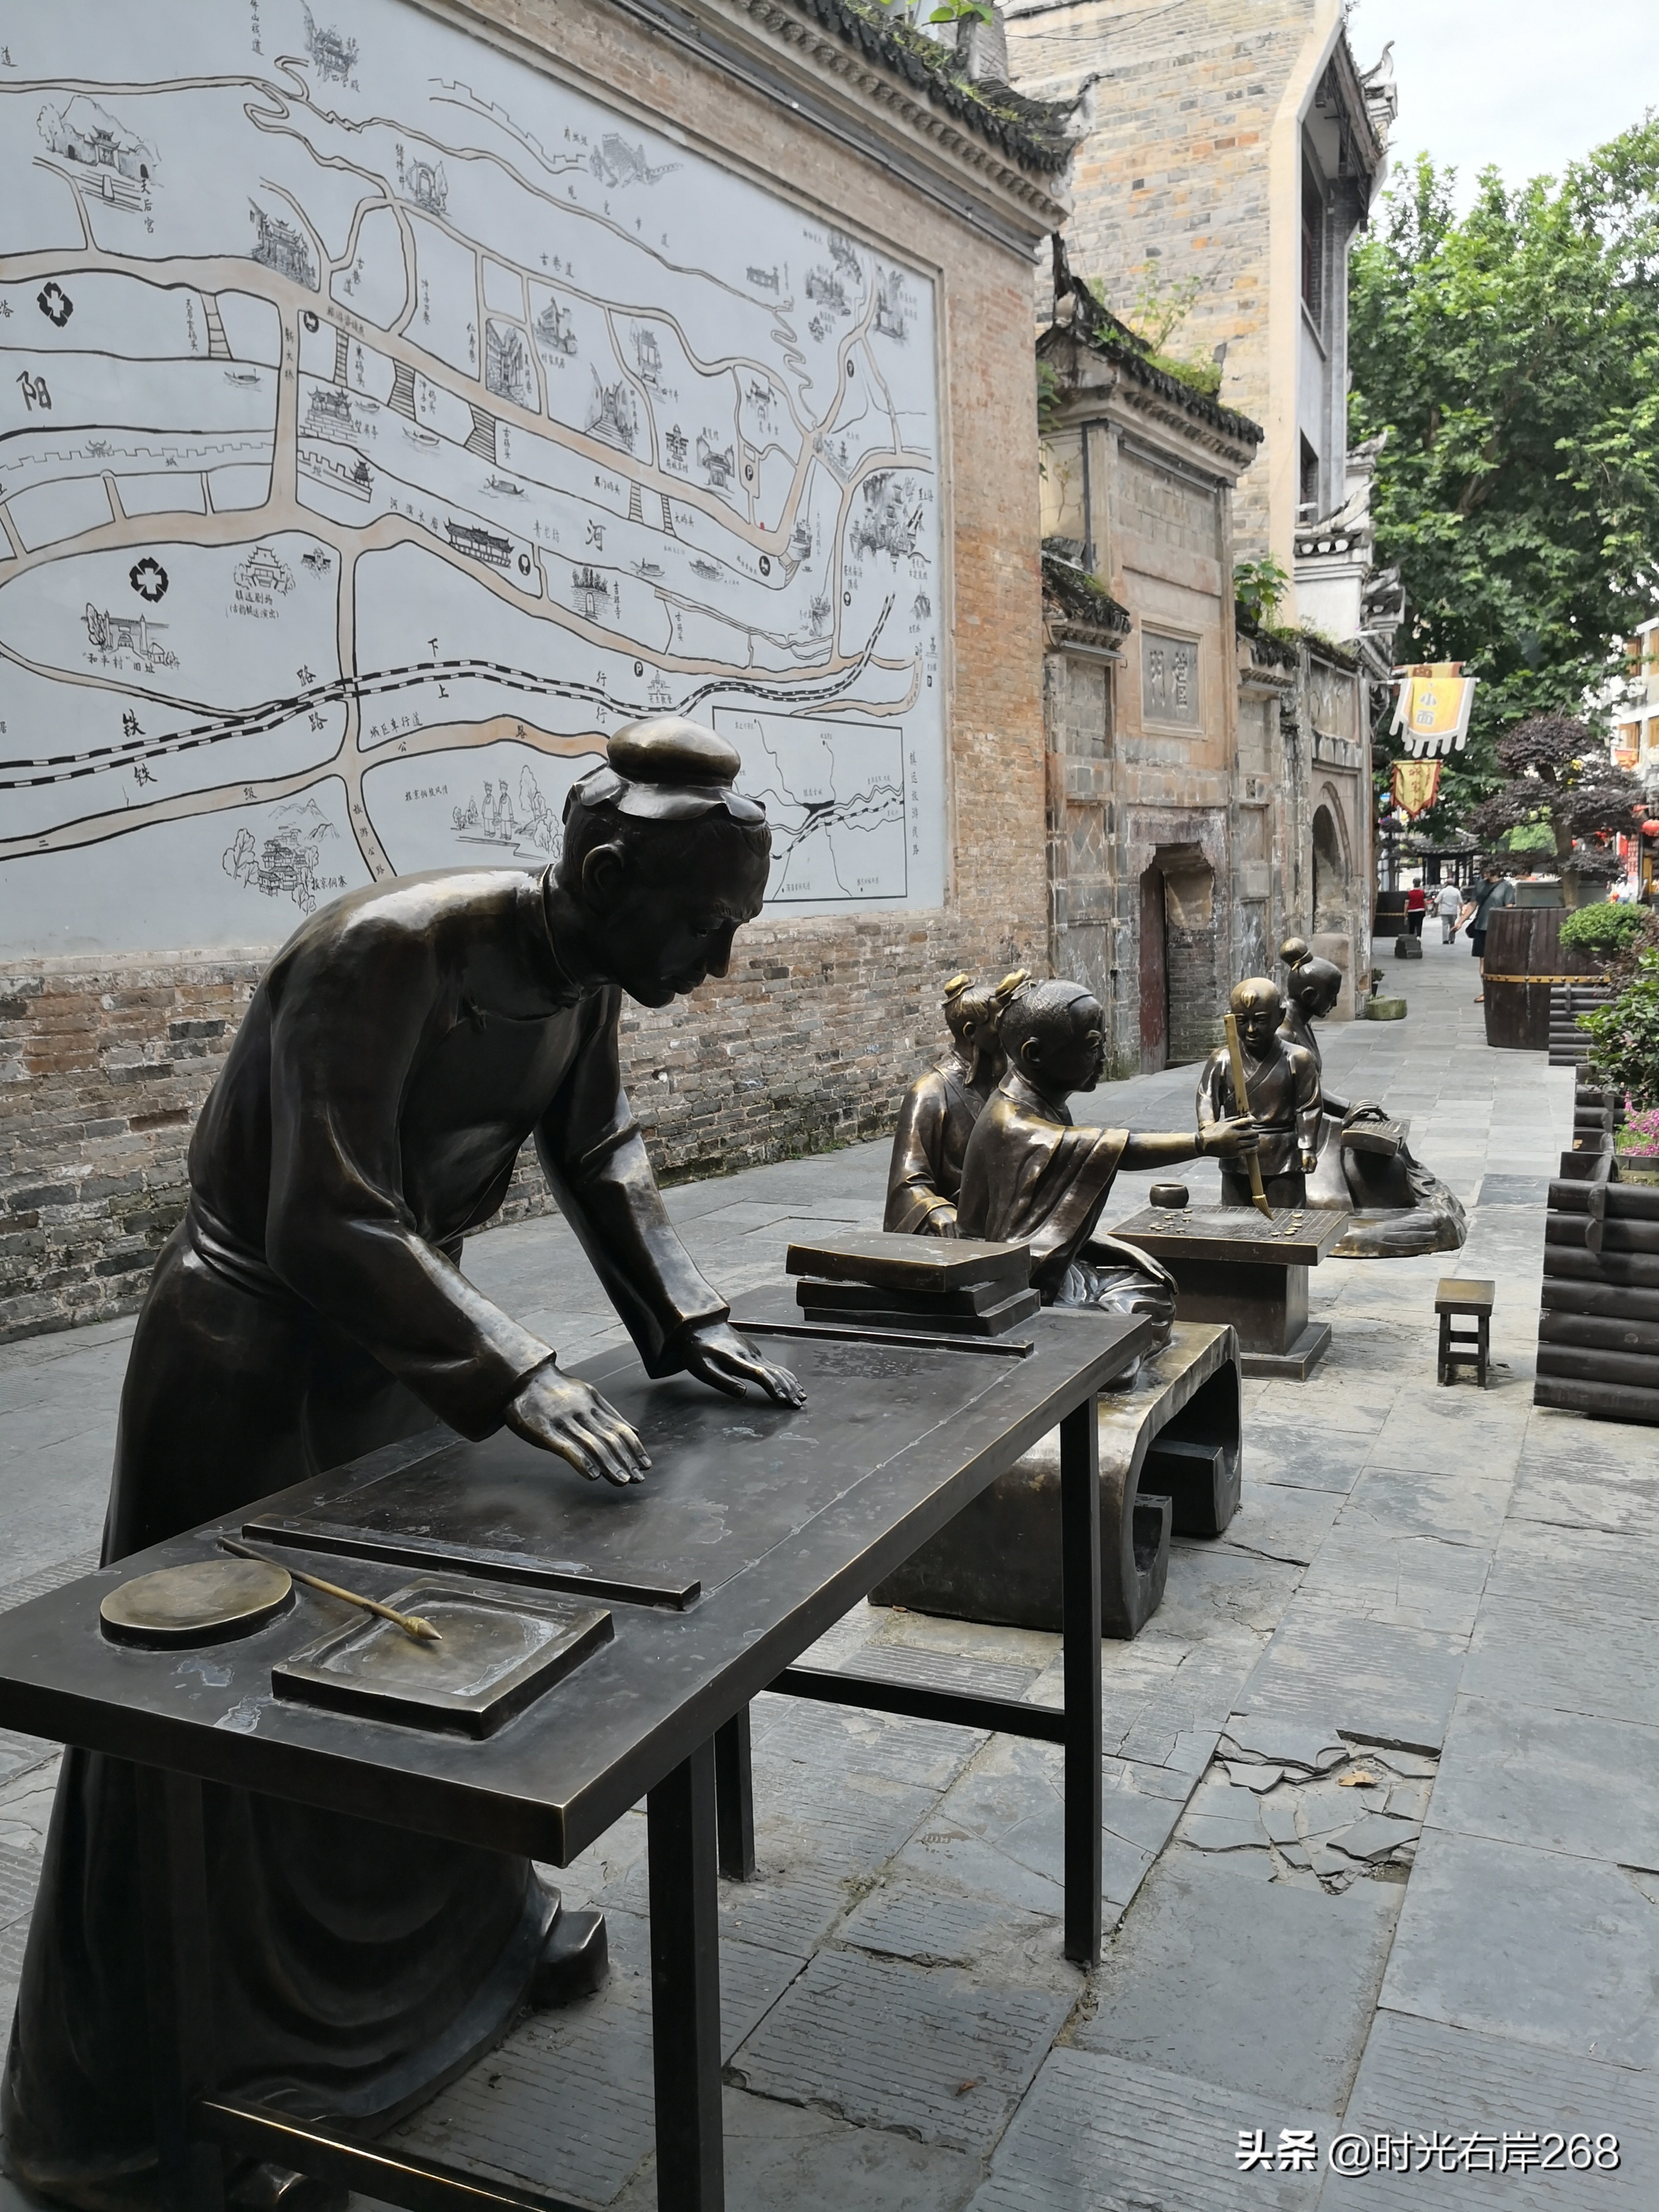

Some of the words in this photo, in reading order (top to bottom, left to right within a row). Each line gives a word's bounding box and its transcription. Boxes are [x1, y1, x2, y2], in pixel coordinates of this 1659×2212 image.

[141, 181, 154, 234] 天后宫
[285, 327, 294, 383] 新大桥
[16, 371, 51, 411] 阳
[585, 518, 607, 552] 河
[391, 497, 439, 531] 河滨长廊
[236, 589, 273, 605] 镇远剧场
[123, 709, 146, 736] 铁
[297, 665, 316, 687] 路
[428, 638, 438, 657] 下
[596, 671, 607, 687] 行
[134, 763, 158, 787] 铁
[309, 713, 328, 732] 路
[439, 685, 449, 698] 上
[596, 706, 608, 724] 行
[370, 713, 423, 739] 城区车行道
[244, 788, 257, 800] 级
[398, 741, 406, 752] 公
[516, 725, 527, 738] 路
[353, 803, 385, 876] 旅游公路
[312, 876, 347, 890] 报京侗寨
